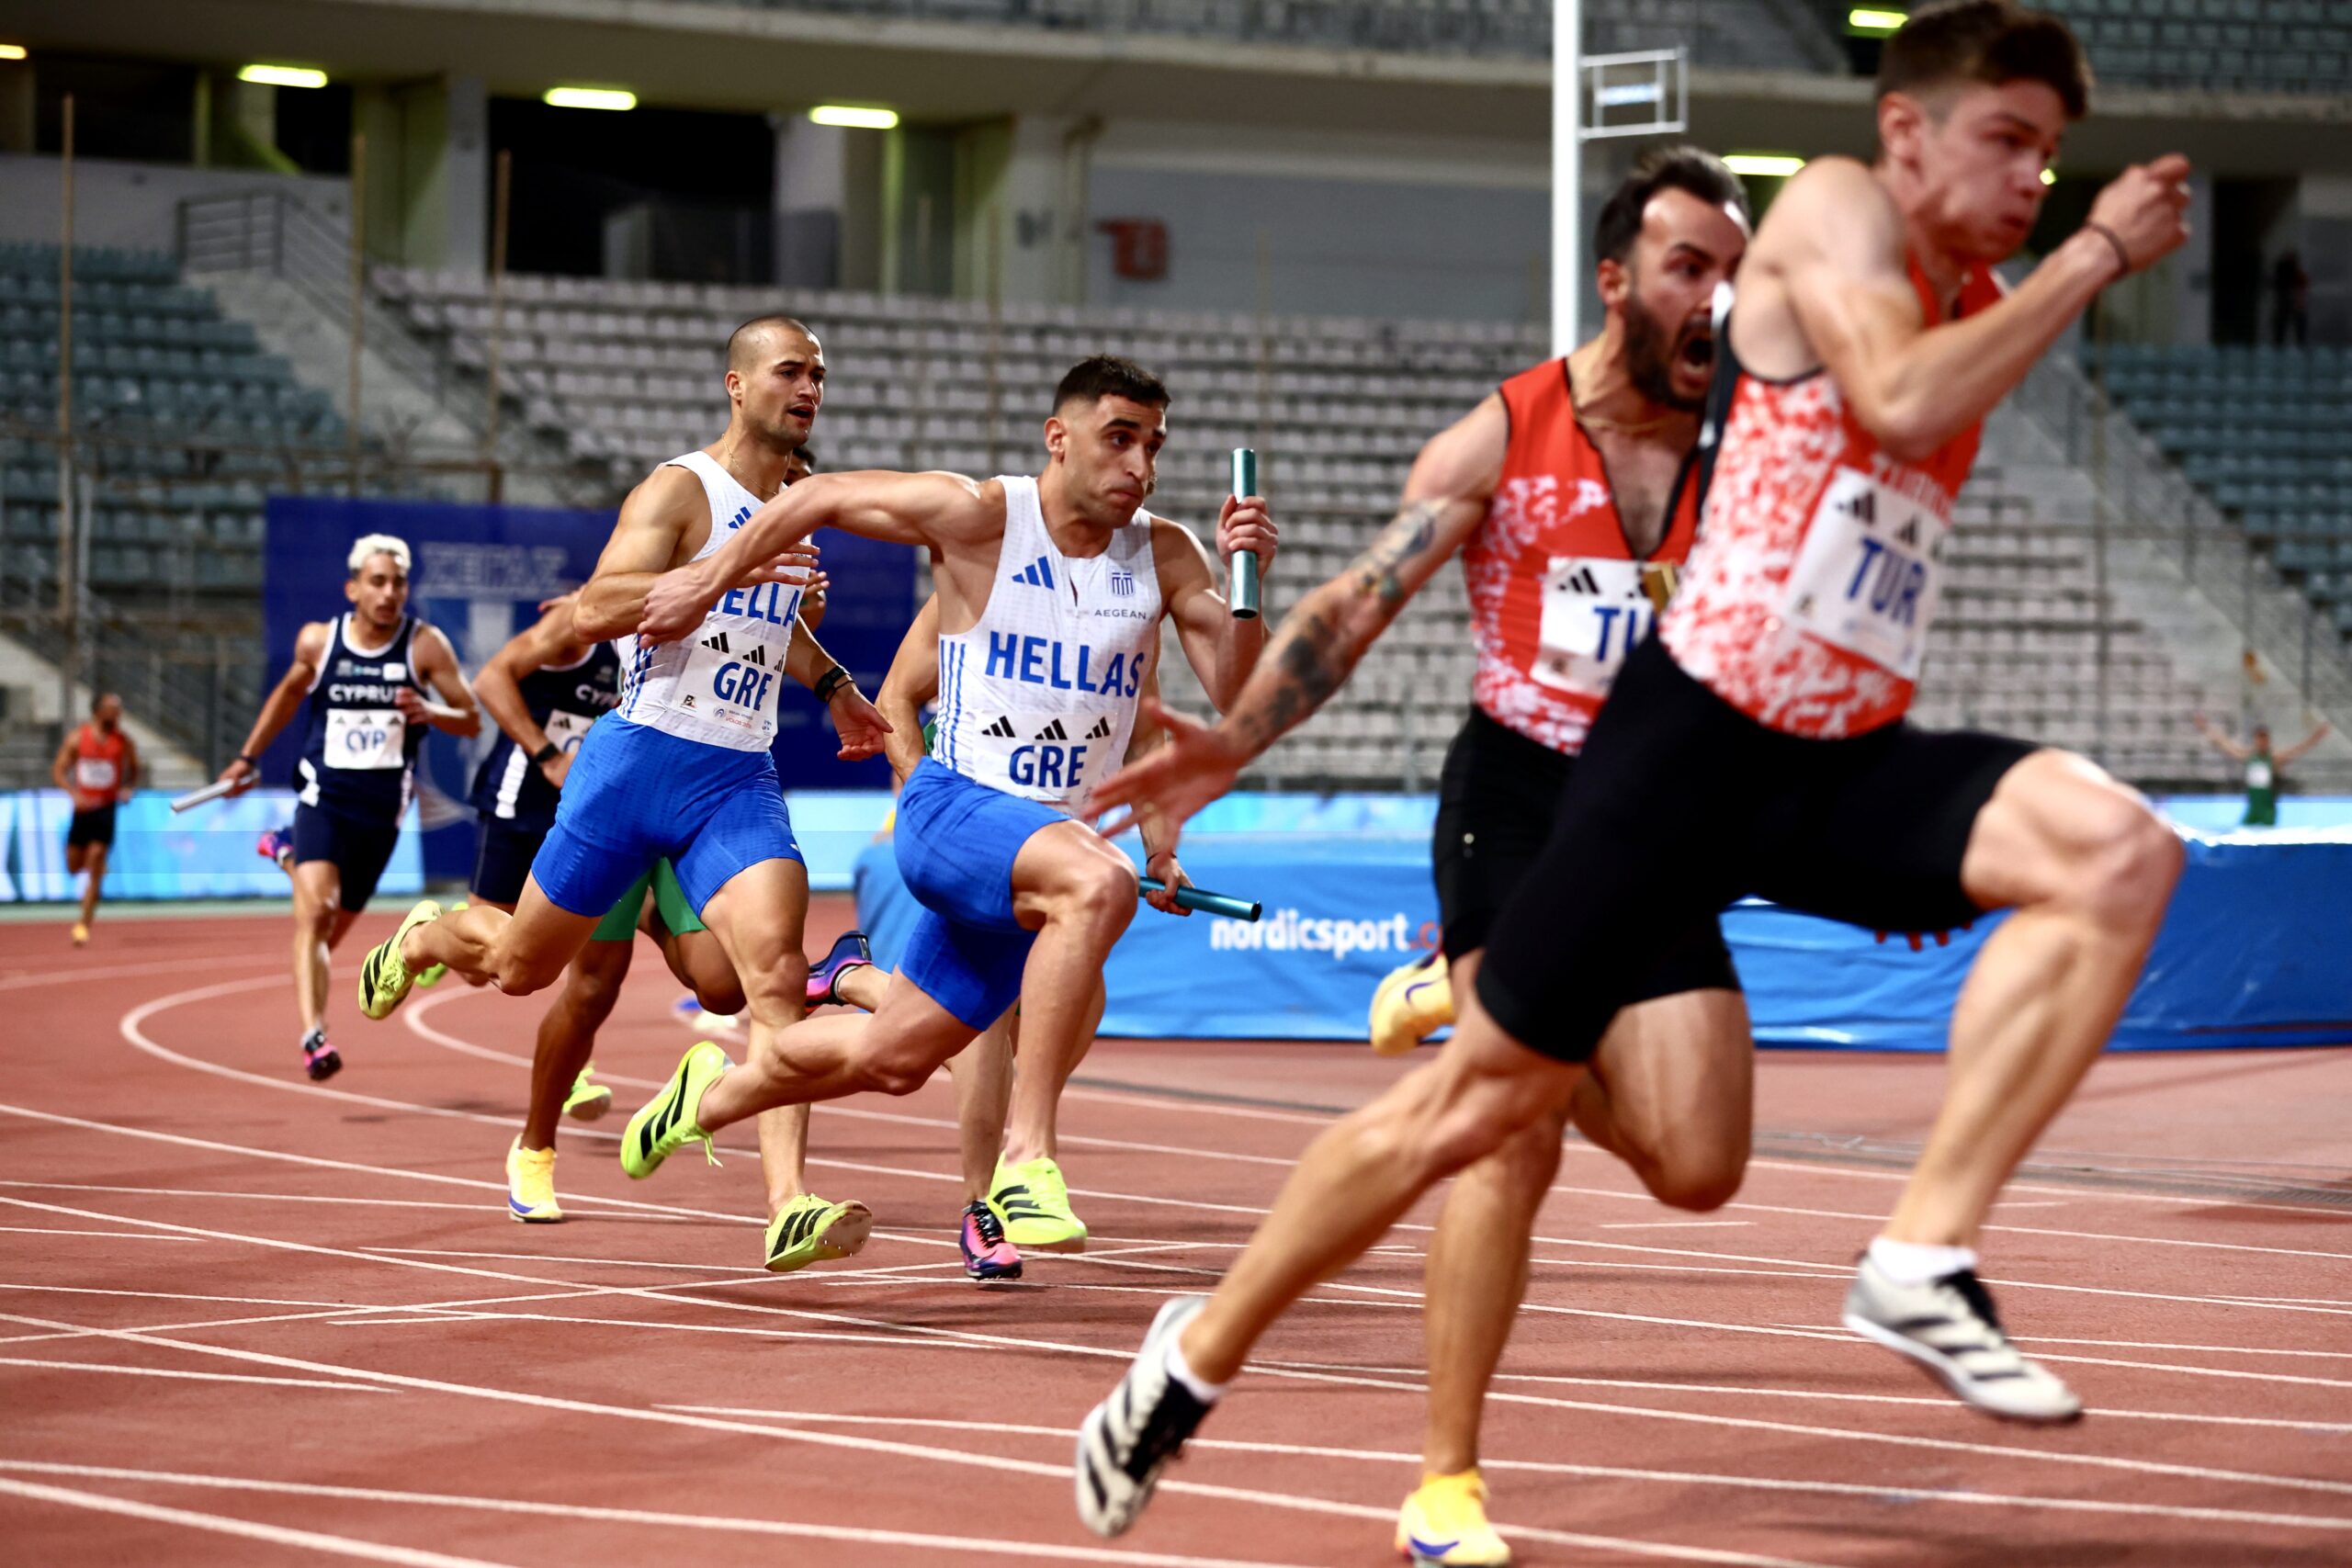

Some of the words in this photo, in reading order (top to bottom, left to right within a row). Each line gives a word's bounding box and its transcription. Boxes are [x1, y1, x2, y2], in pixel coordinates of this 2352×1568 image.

[708, 581, 800, 627] ELLA
[1846, 536, 1927, 626] TUR
[1094, 609, 1148, 620] AEGEAN
[985, 631, 1145, 698] HELLAS
[329, 683, 402, 703] CYPRU
[1009, 745, 1088, 787] GRE
[1210, 909, 1443, 961] nordicsport.c
